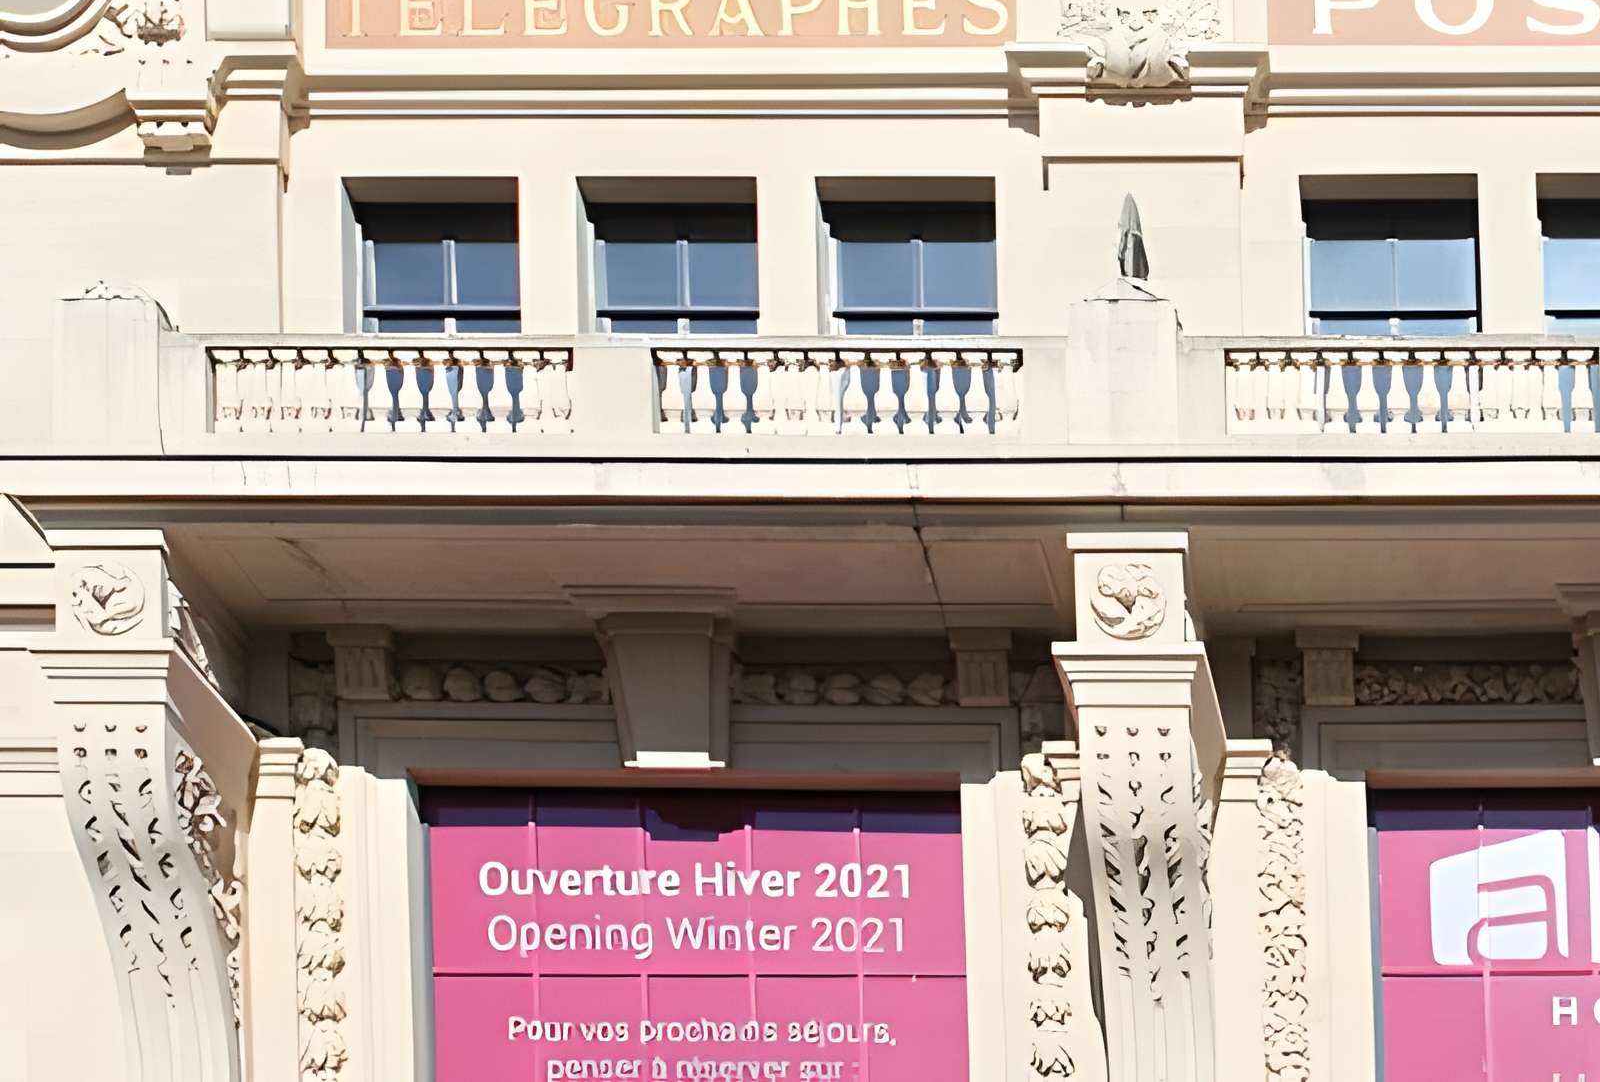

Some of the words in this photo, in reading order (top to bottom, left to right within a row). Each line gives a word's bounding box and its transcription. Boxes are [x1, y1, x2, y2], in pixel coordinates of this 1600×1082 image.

[478, 861, 681, 898] Ouverture
[694, 861, 801, 898] Hiver
[814, 863, 910, 899] 2021
[487, 915, 654, 960] Opening
[666, 914, 798, 952] Winter
[811, 917, 905, 952] 2021
[508, 1017, 571, 1042] Pour
[580, 1021, 629, 1042] vos
